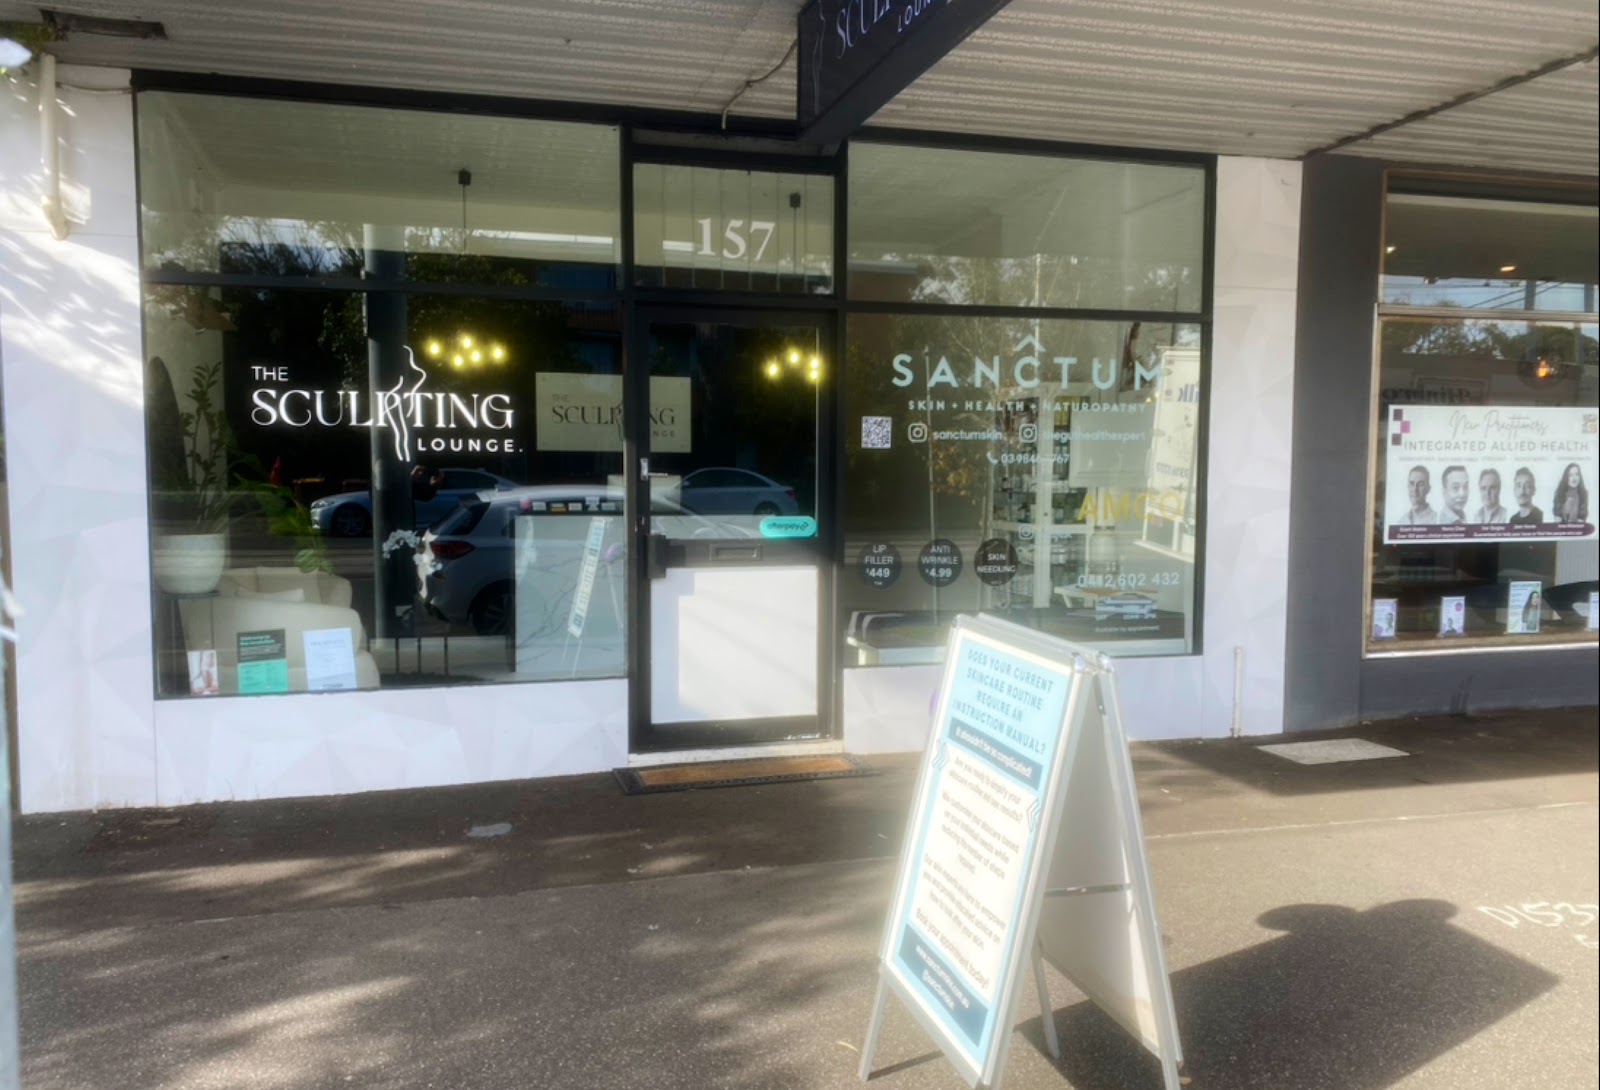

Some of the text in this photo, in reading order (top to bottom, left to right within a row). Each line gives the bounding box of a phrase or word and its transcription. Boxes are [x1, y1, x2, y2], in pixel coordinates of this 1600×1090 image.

[697, 217, 776, 261] 157
[251, 366, 289, 382] THE
[892, 353, 1163, 391] SANCTUM
[551, 394, 569, 402] THE
[250, 388, 515, 430] SCULPTING
[908, 400, 946, 411] SKIN
[964, 400, 1026, 411] HEALTH
[1042, 401, 1147, 414] NATUROPATHY
[931, 429, 1003, 440] sanctumskin
[1404, 440, 1589, 452] INTEGRATED ALLIED HEALTH
[872, 545, 887, 553] LIP
[930, 545, 951, 554] ANTI
[864, 556, 894, 565] FILLER
[921, 556, 959, 565] WRINKLE
[987, 553, 1006, 561] SKIN
[976, 566, 1016, 574] NEEDLING
[1117, 573, 1146, 587] 602
[1151, 571, 1180, 586] 432
[967, 648, 1054, 693] DOES YOUR CURRENT
[966, 667, 1043, 710] SKINCARE ROUTINE
[975, 690, 1023, 721] REQUIRE AN
[951, 698, 1046, 755] INSTRUCTION MANUAL?
